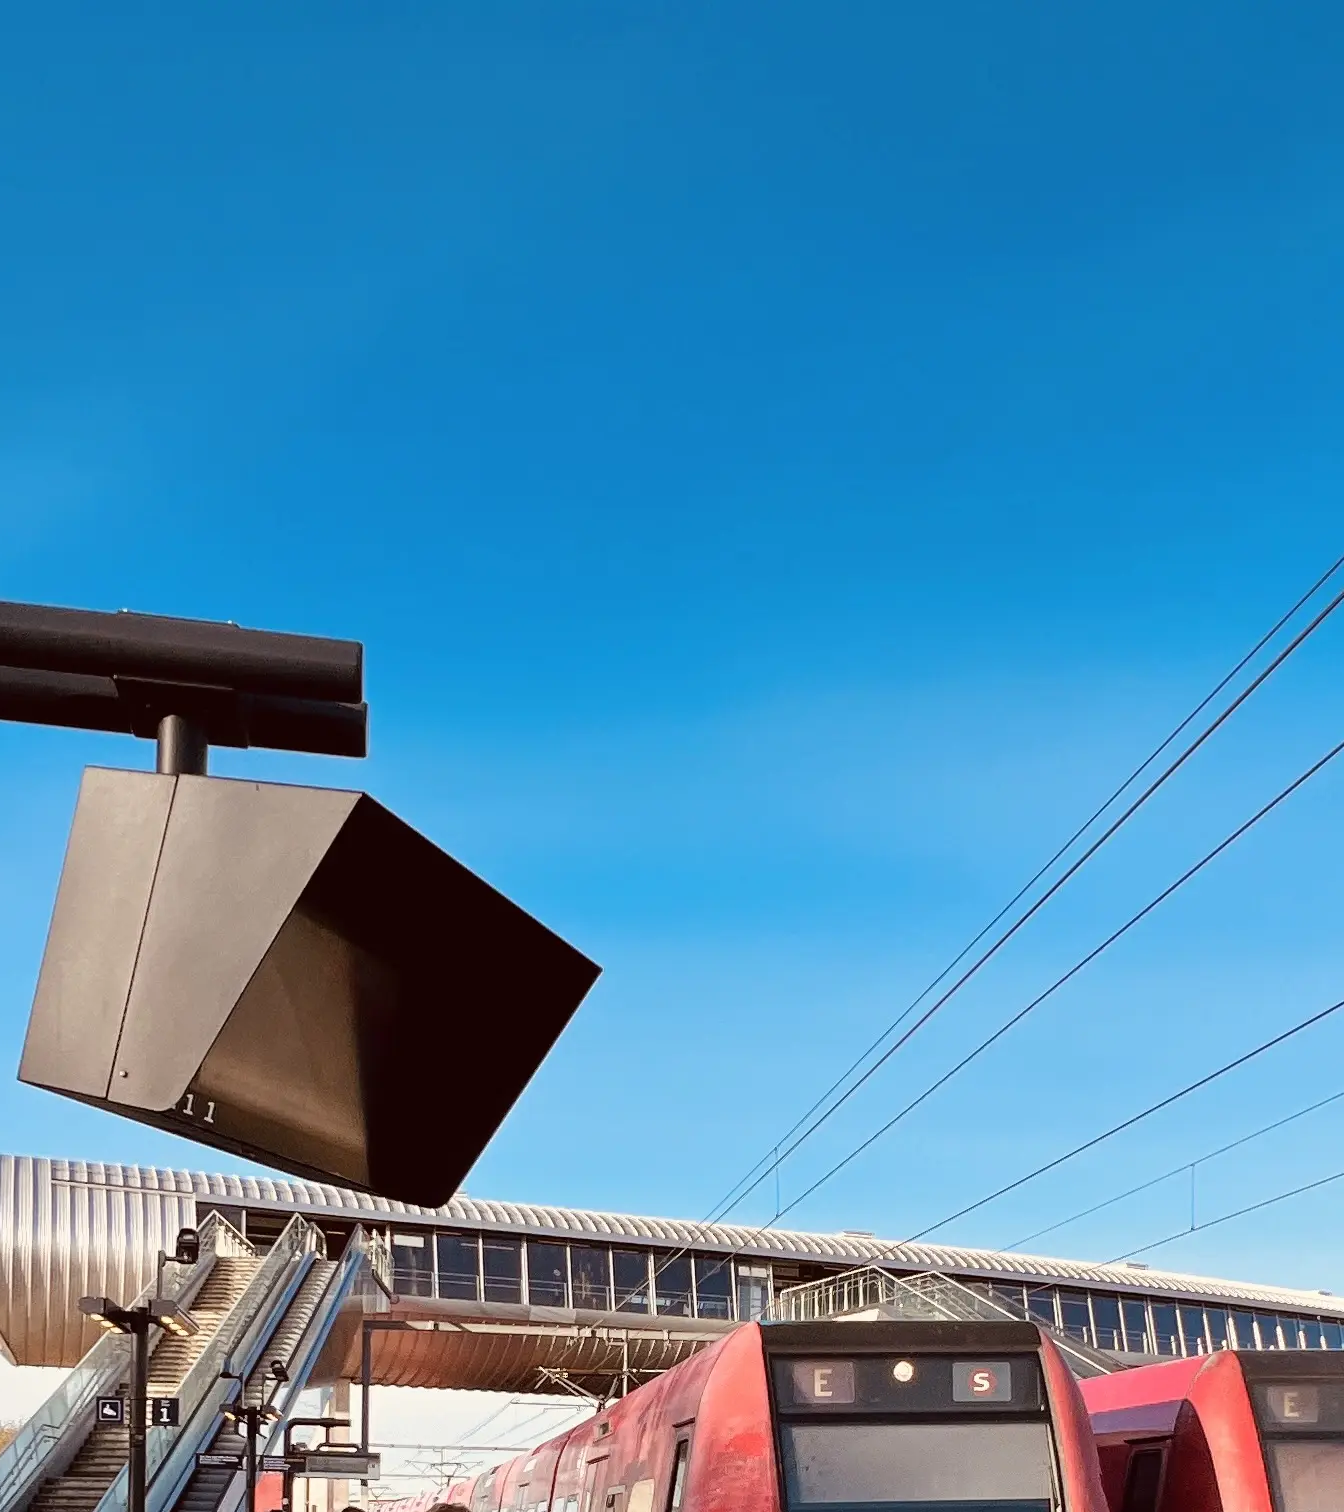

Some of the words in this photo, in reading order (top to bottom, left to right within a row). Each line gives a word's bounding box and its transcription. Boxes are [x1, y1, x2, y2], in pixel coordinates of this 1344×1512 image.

[813, 1368, 833, 1397] E
[973, 1372, 991, 1392] S
[159, 1407, 172, 1423] 1
[1282, 1391, 1300, 1418] E
